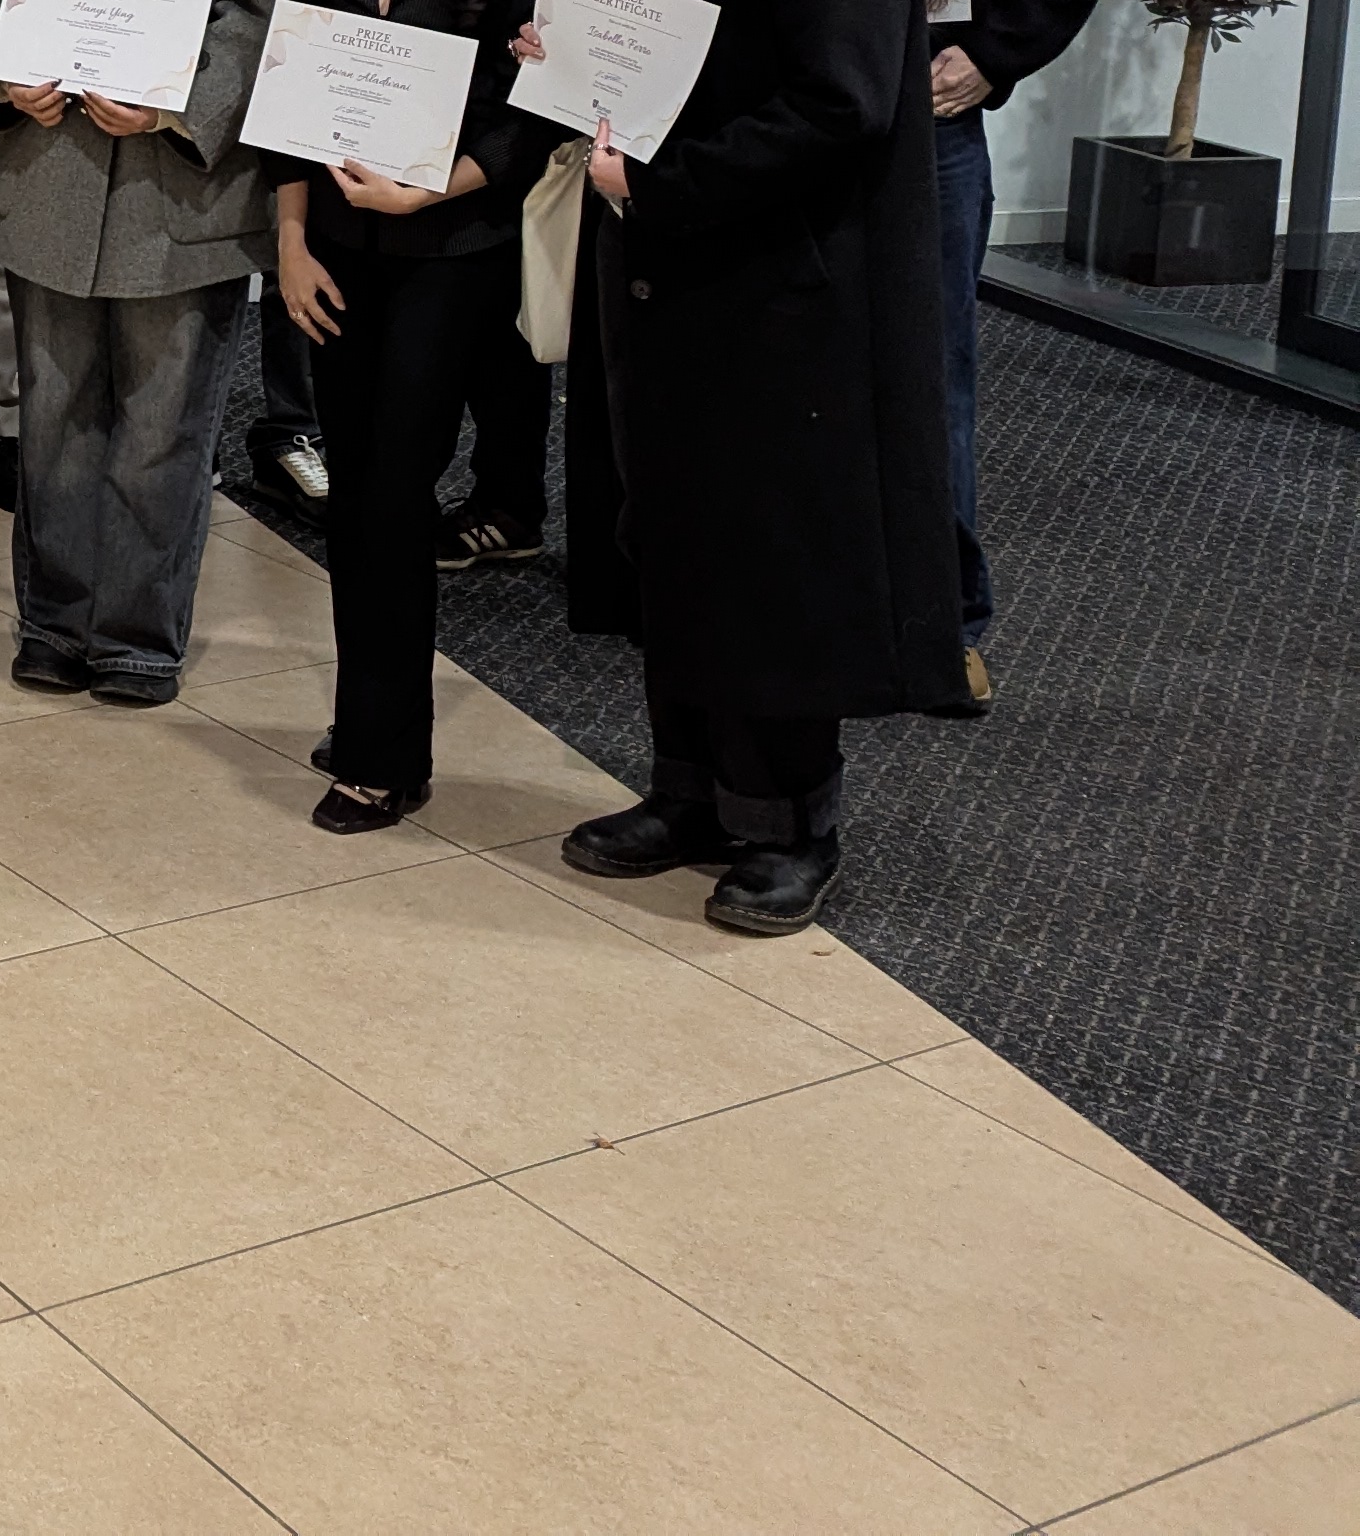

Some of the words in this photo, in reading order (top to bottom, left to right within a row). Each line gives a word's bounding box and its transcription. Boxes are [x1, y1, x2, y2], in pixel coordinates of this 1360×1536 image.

[332, 33, 412, 58] CERTIFICATE
[356, 27, 392, 44] PRIZE
[586, 25, 624, 46] Isabella
